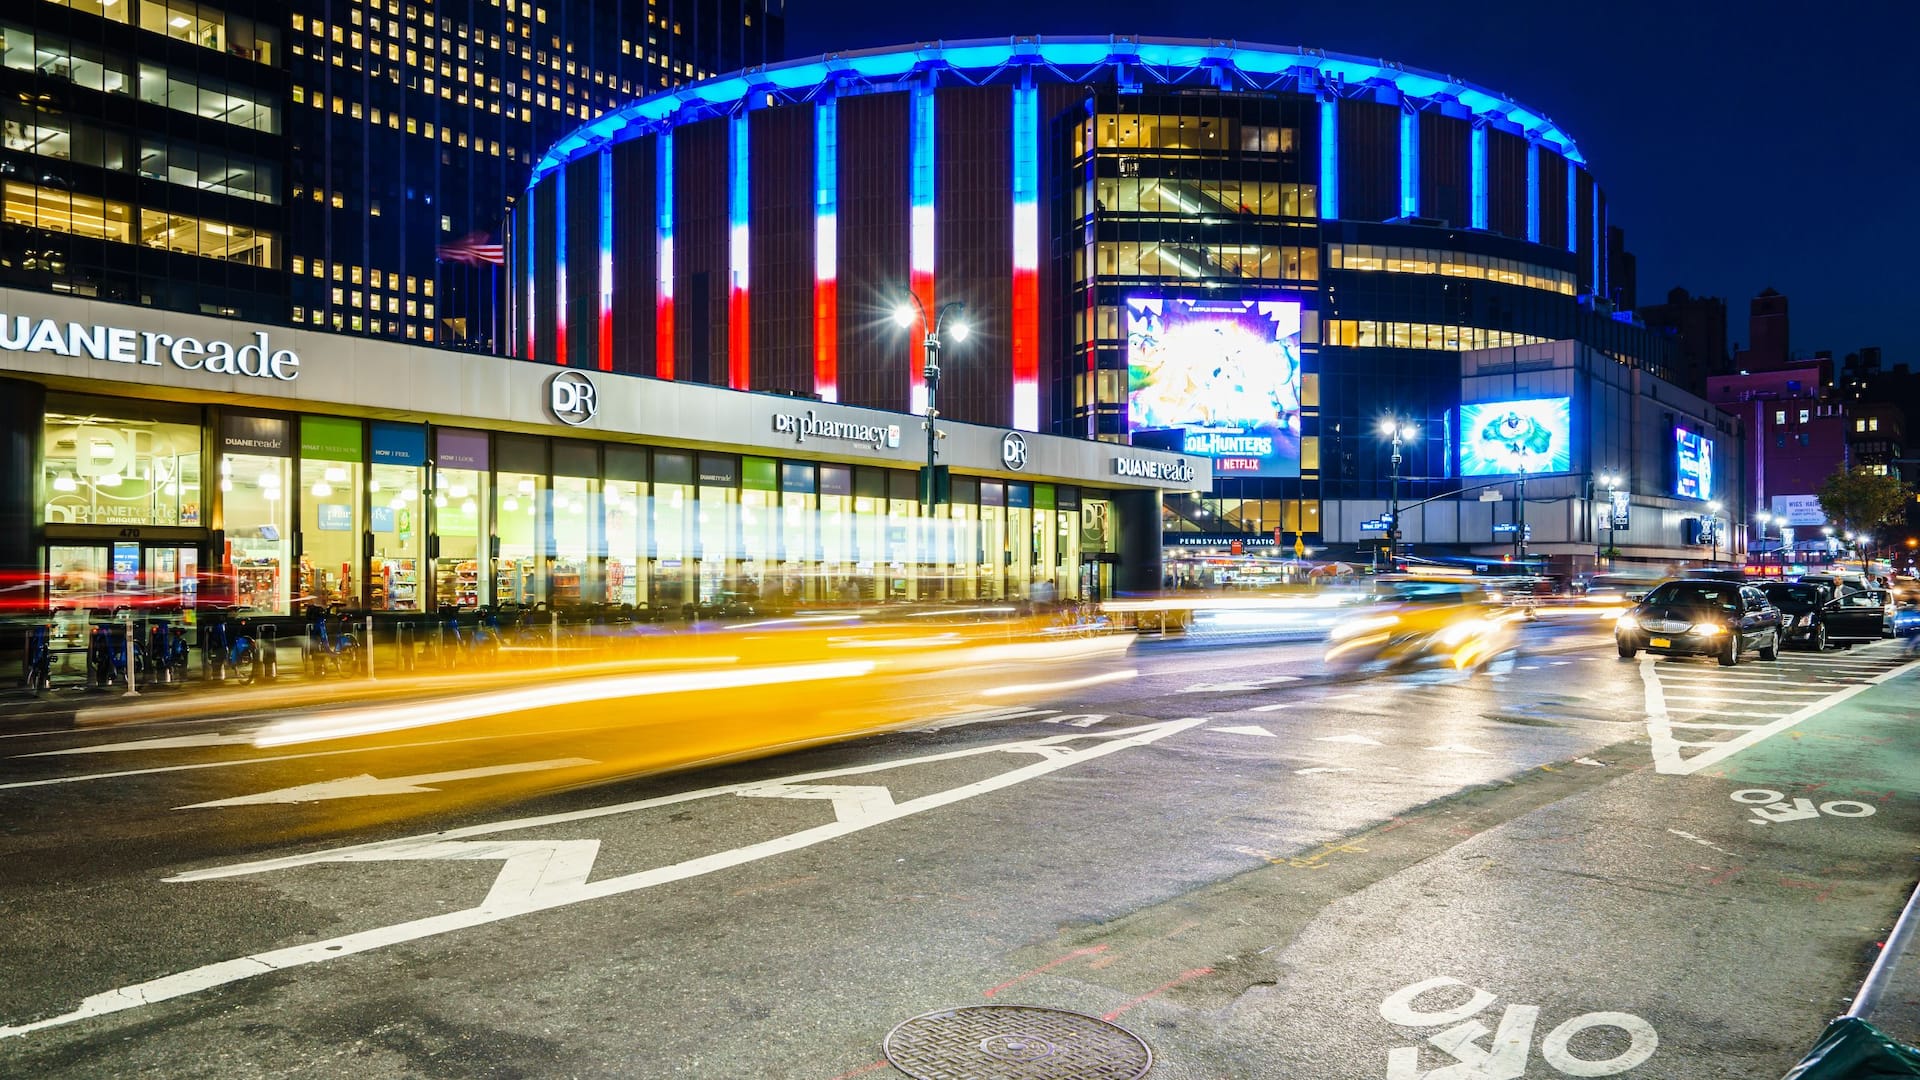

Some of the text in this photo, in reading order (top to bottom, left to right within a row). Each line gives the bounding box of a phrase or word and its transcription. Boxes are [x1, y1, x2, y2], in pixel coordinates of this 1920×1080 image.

[0, 313, 300, 381] UANEreade
[552, 380, 598, 416] DR
[775, 410, 889, 450] DR pharmacy
[1003, 439, 1027, 464] DR
[1117, 457, 1194, 482] DUANEreade
[1223, 458, 1259, 471] NETFLIX
[119, 528, 141, 538] 470
[1246, 538, 1275, 546] STATIO
